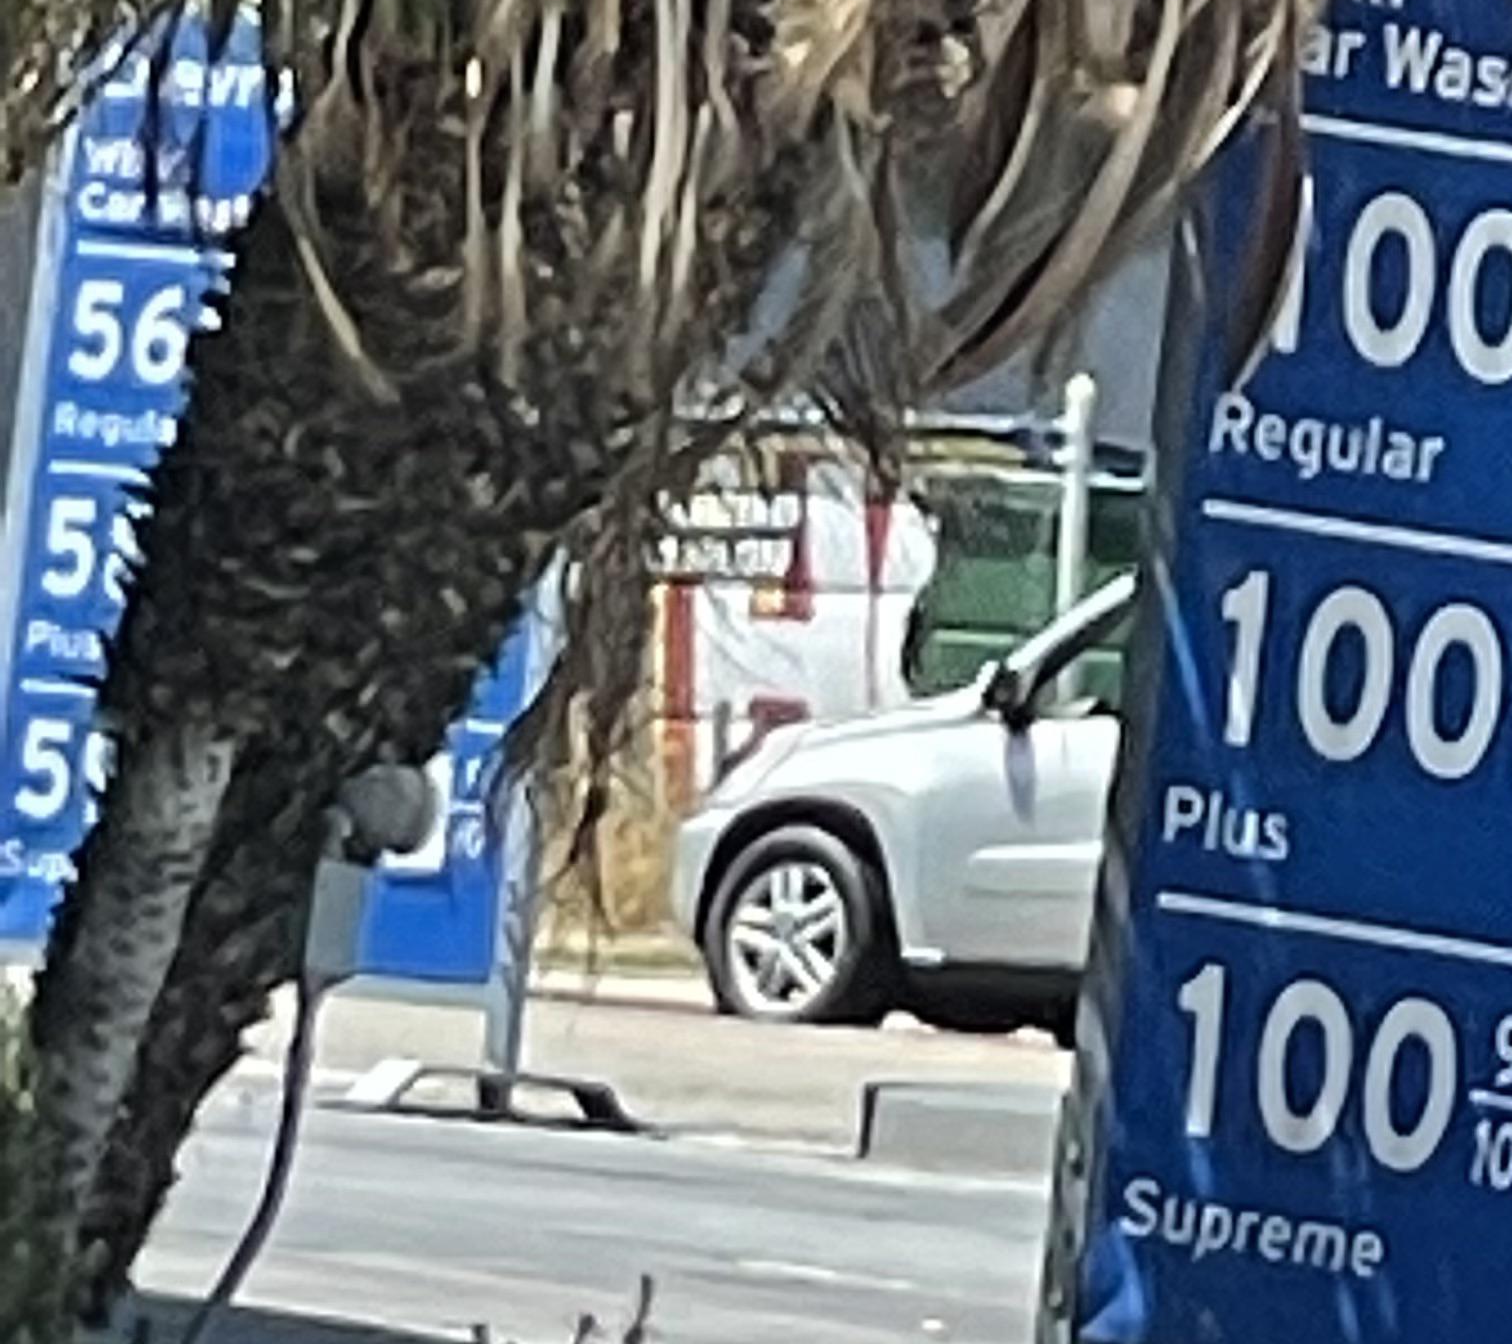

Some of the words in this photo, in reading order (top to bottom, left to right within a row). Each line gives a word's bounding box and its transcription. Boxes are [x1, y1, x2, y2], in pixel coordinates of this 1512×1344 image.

[1208, 390, 1445, 483] Regular
[1222, 570, 1502, 779] 100
[1163, 785, 1289, 861] Plus
[1178, 964, 1456, 1171] 100
[1119, 1179, 1385, 1278] Supreme
